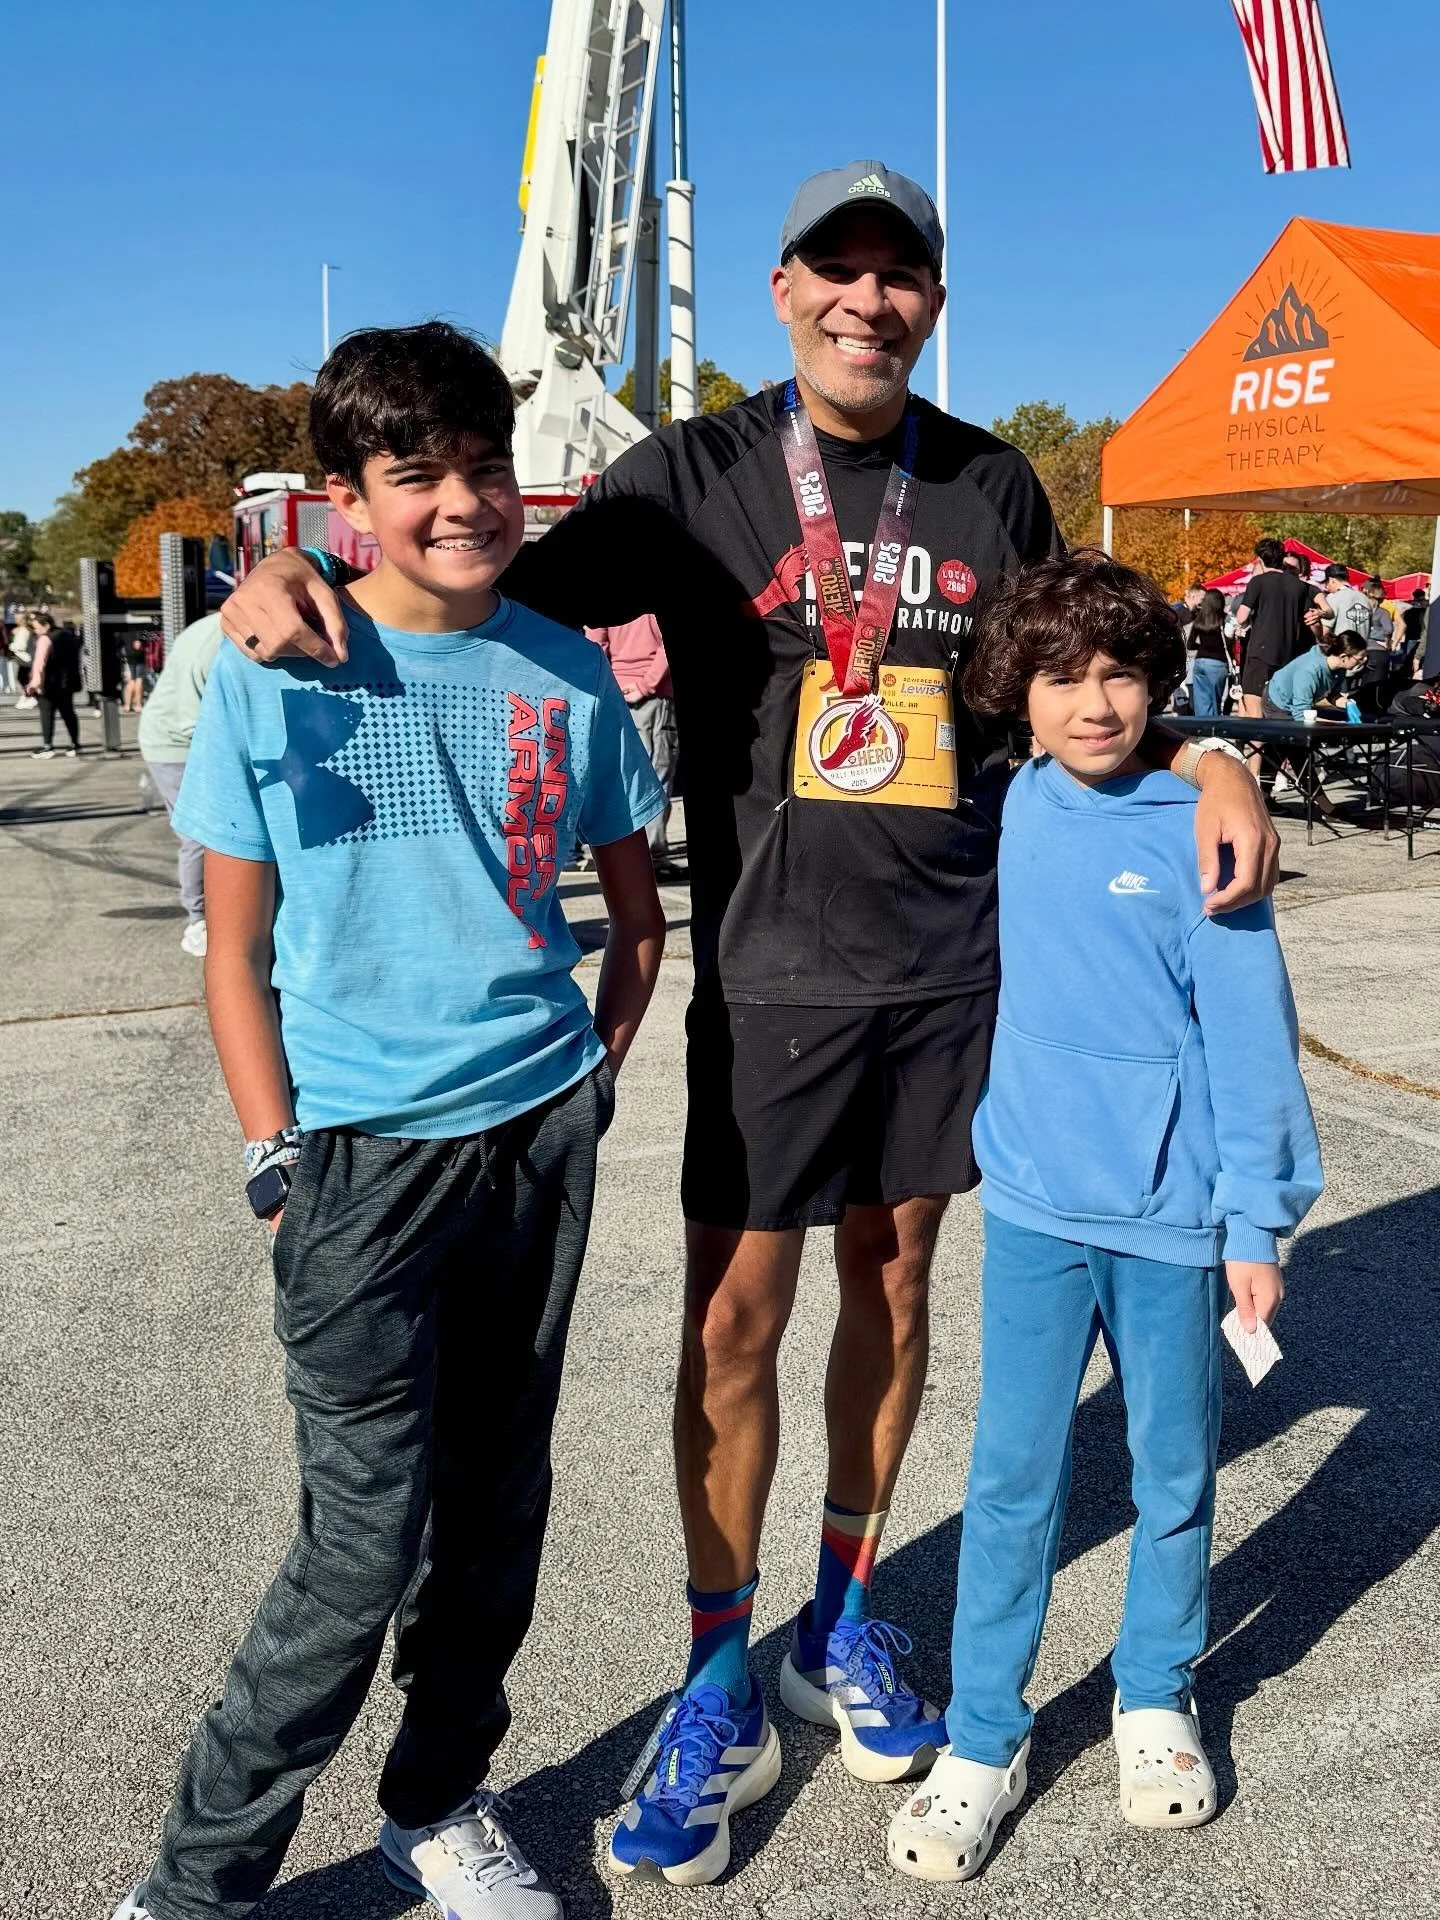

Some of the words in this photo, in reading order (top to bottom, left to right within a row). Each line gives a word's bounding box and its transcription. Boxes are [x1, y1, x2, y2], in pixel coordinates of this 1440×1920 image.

[1230, 358, 1336, 415] RISE
[1227, 413, 1326, 443] PHYSICAL
[1226, 443, 1326, 472] THERAPY
[797, 470, 827, 517] 2025
[872, 540, 901, 585] 2025
[942, 569, 971, 582] LOCAL
[819, 574, 845, 614] HERO
[897, 607, 974, 637] RATHON
[900, 683, 936, 695] Lewis
[857, 747, 894, 766] HERO
[851, 779, 868, 787] 2025
[531, 697, 569, 900] UNDER
[503, 691, 548, 950] ARMOU
[1118, 870, 1149, 888] NIKE
